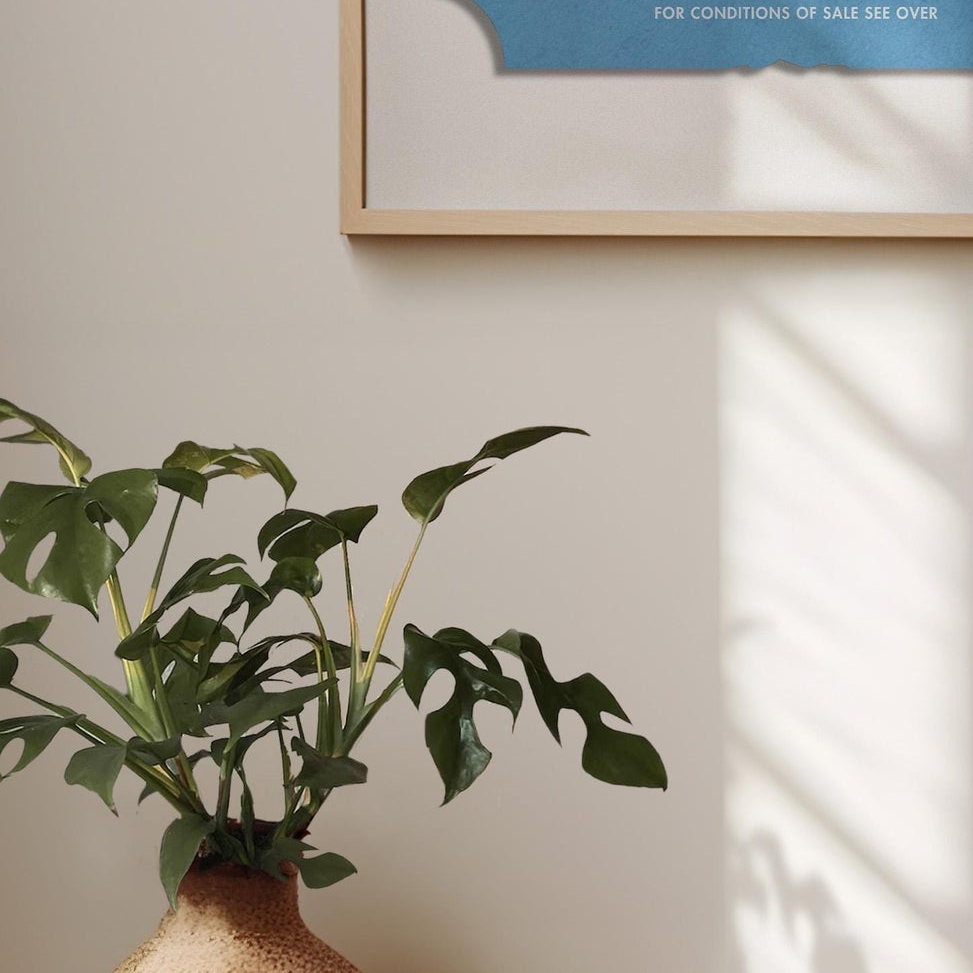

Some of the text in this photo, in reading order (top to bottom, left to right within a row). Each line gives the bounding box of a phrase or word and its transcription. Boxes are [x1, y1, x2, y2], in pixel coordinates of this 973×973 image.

[655, 7, 937, 19] FOR CONDITIONS OF SALE SEE OVER
